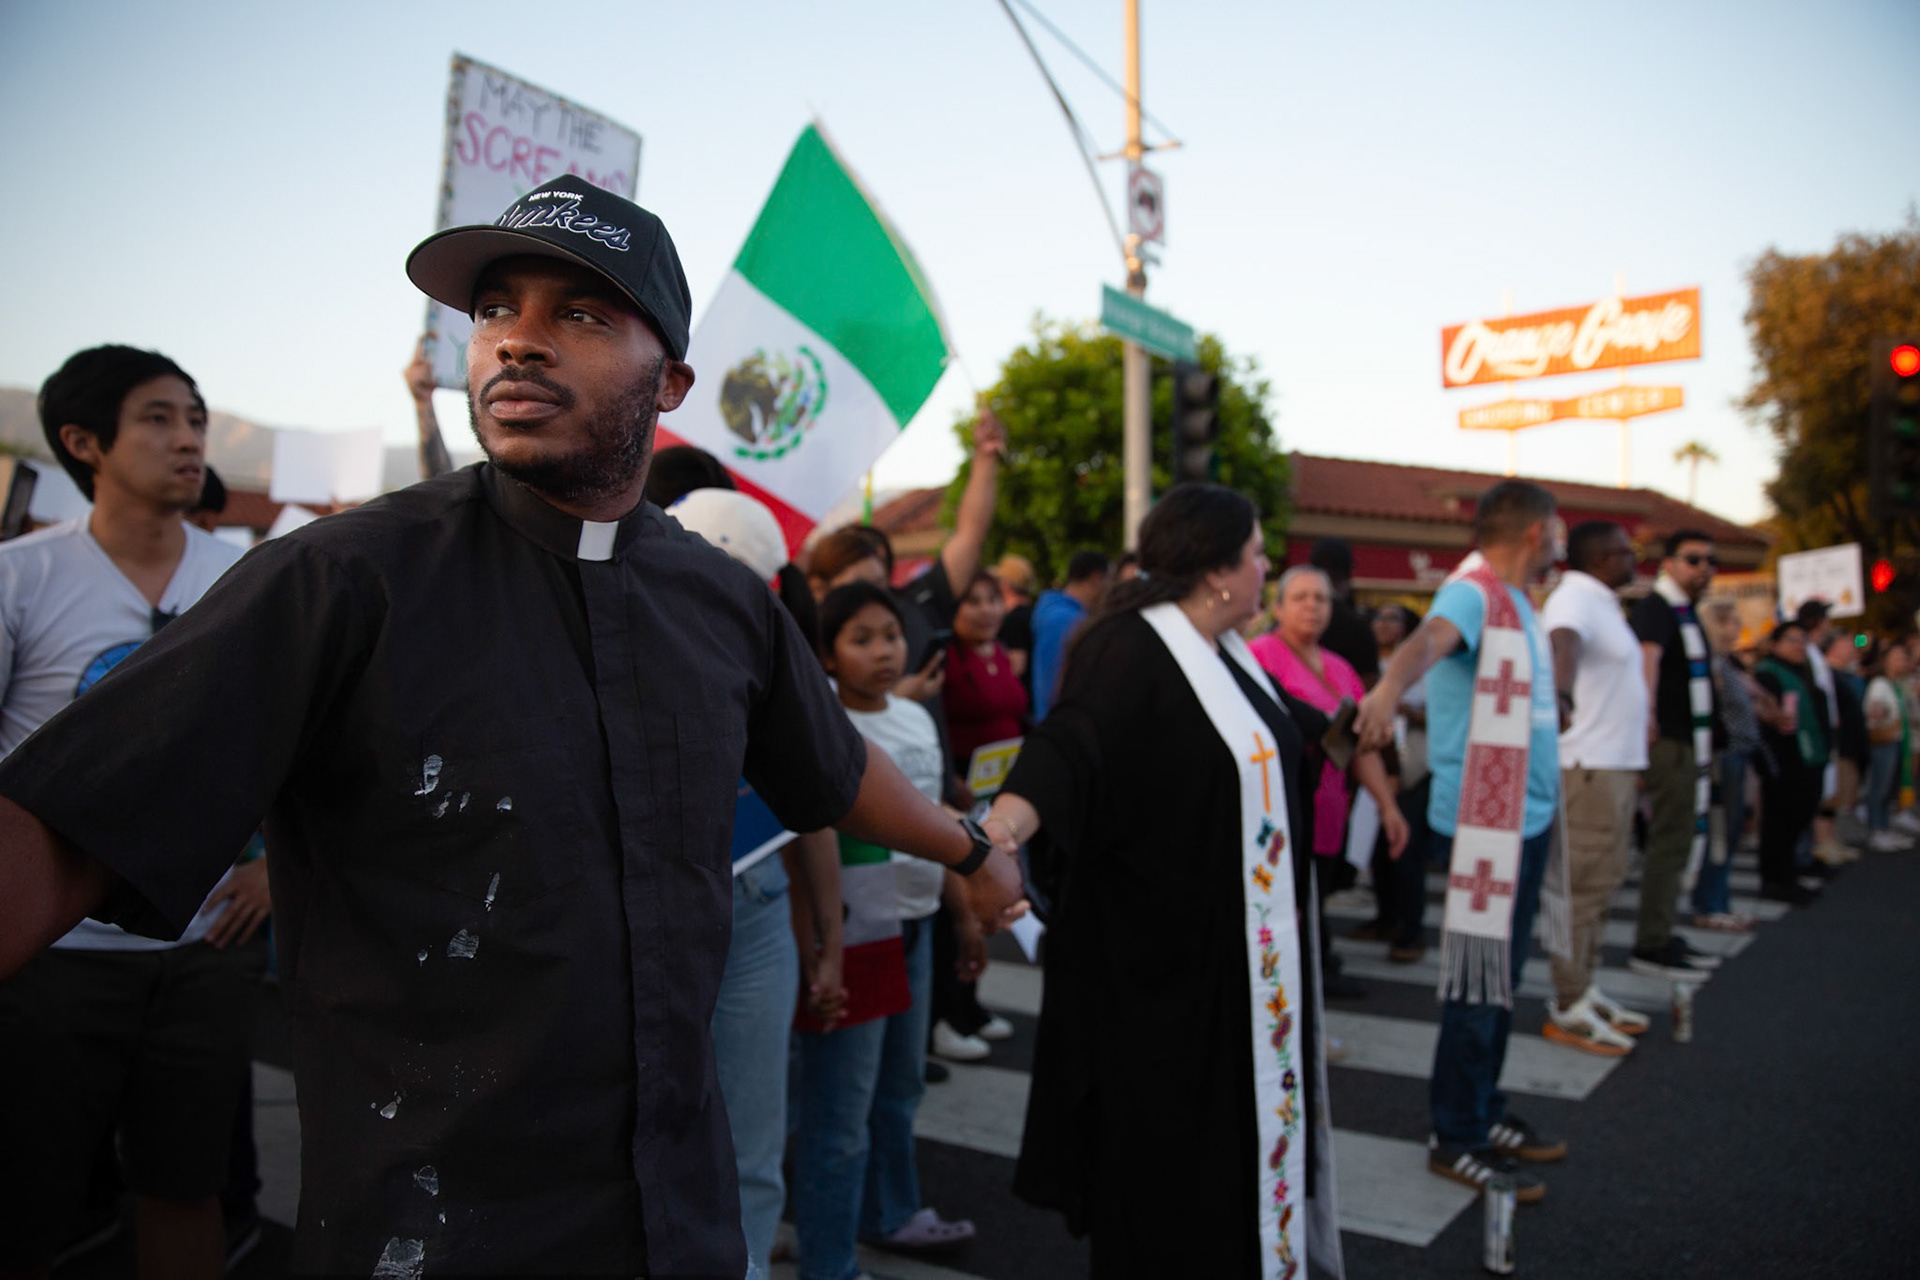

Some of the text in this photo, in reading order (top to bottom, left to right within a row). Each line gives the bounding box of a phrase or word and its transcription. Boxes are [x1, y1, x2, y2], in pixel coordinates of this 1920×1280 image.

[478, 72, 606, 154] MAY THE
[528, 191, 552, 202] NEW
[553, 191, 584, 201] YORK
